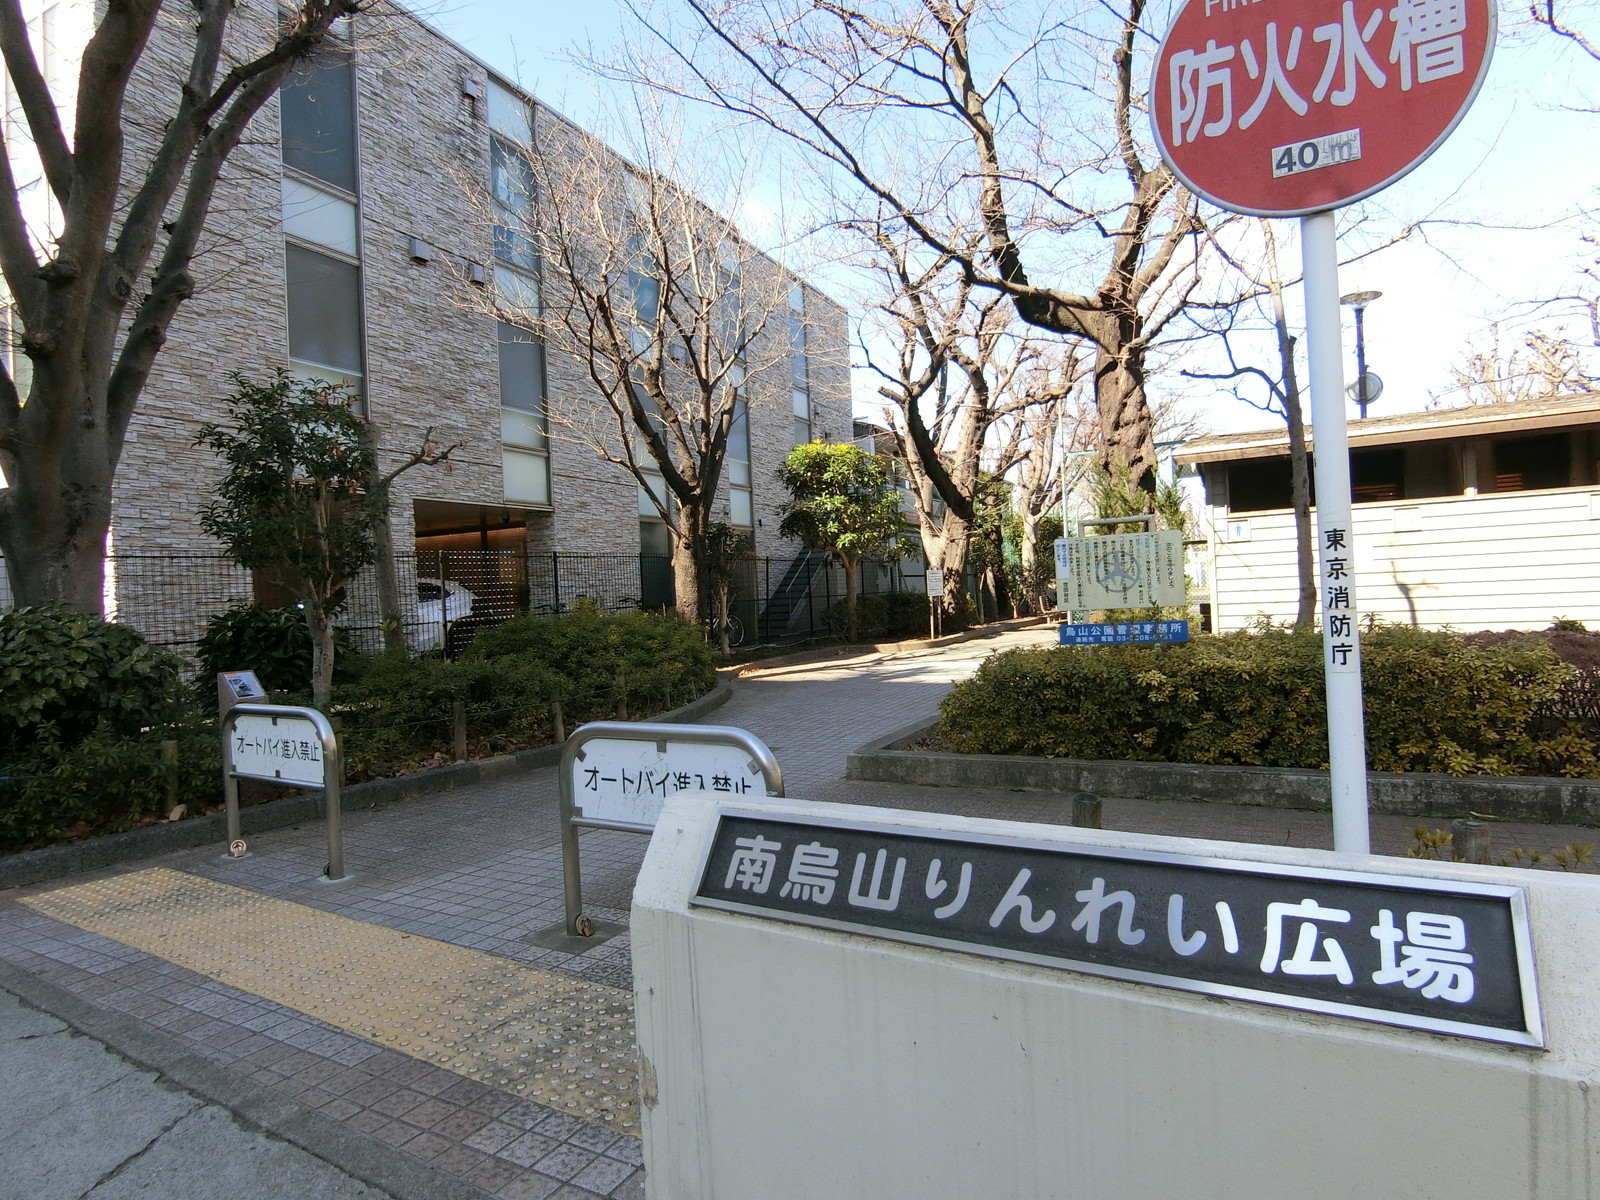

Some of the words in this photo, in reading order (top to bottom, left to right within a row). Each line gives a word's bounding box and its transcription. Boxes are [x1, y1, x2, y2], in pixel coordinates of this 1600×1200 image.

[1169, 0, 1467, 148] 防火水槽
[1324, 528, 1353, 666] 東京消防庁
[237, 736, 321, 762] オートバイ進入禁止
[723, 834, 1476, 1005] 南烏山りんれい広場
